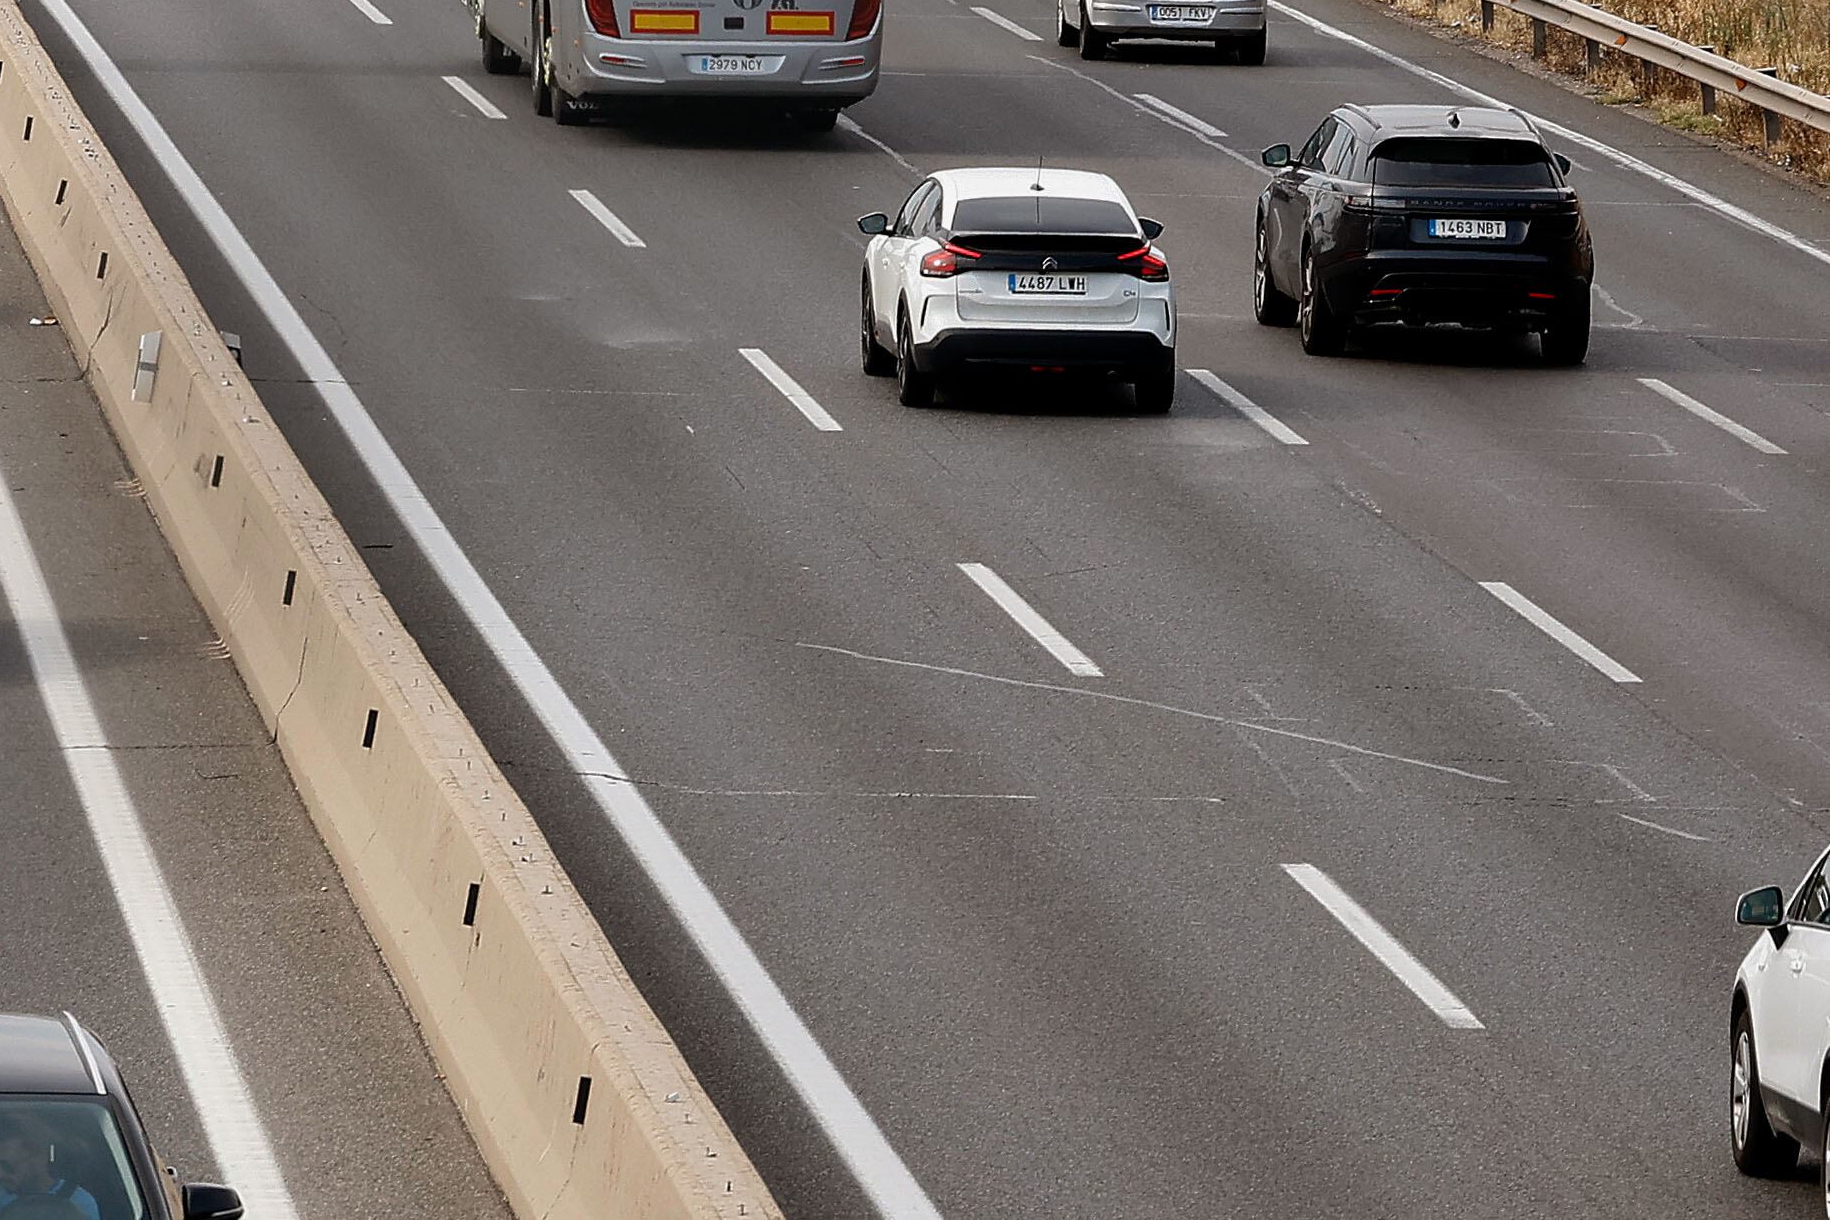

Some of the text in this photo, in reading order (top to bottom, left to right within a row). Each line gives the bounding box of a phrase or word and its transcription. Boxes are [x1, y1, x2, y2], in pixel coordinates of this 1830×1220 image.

[708, 59, 763, 70] 2979 NCY
[1441, 221, 1503, 235] 1463 NBT
[1019, 276, 1054, 291] 4487
